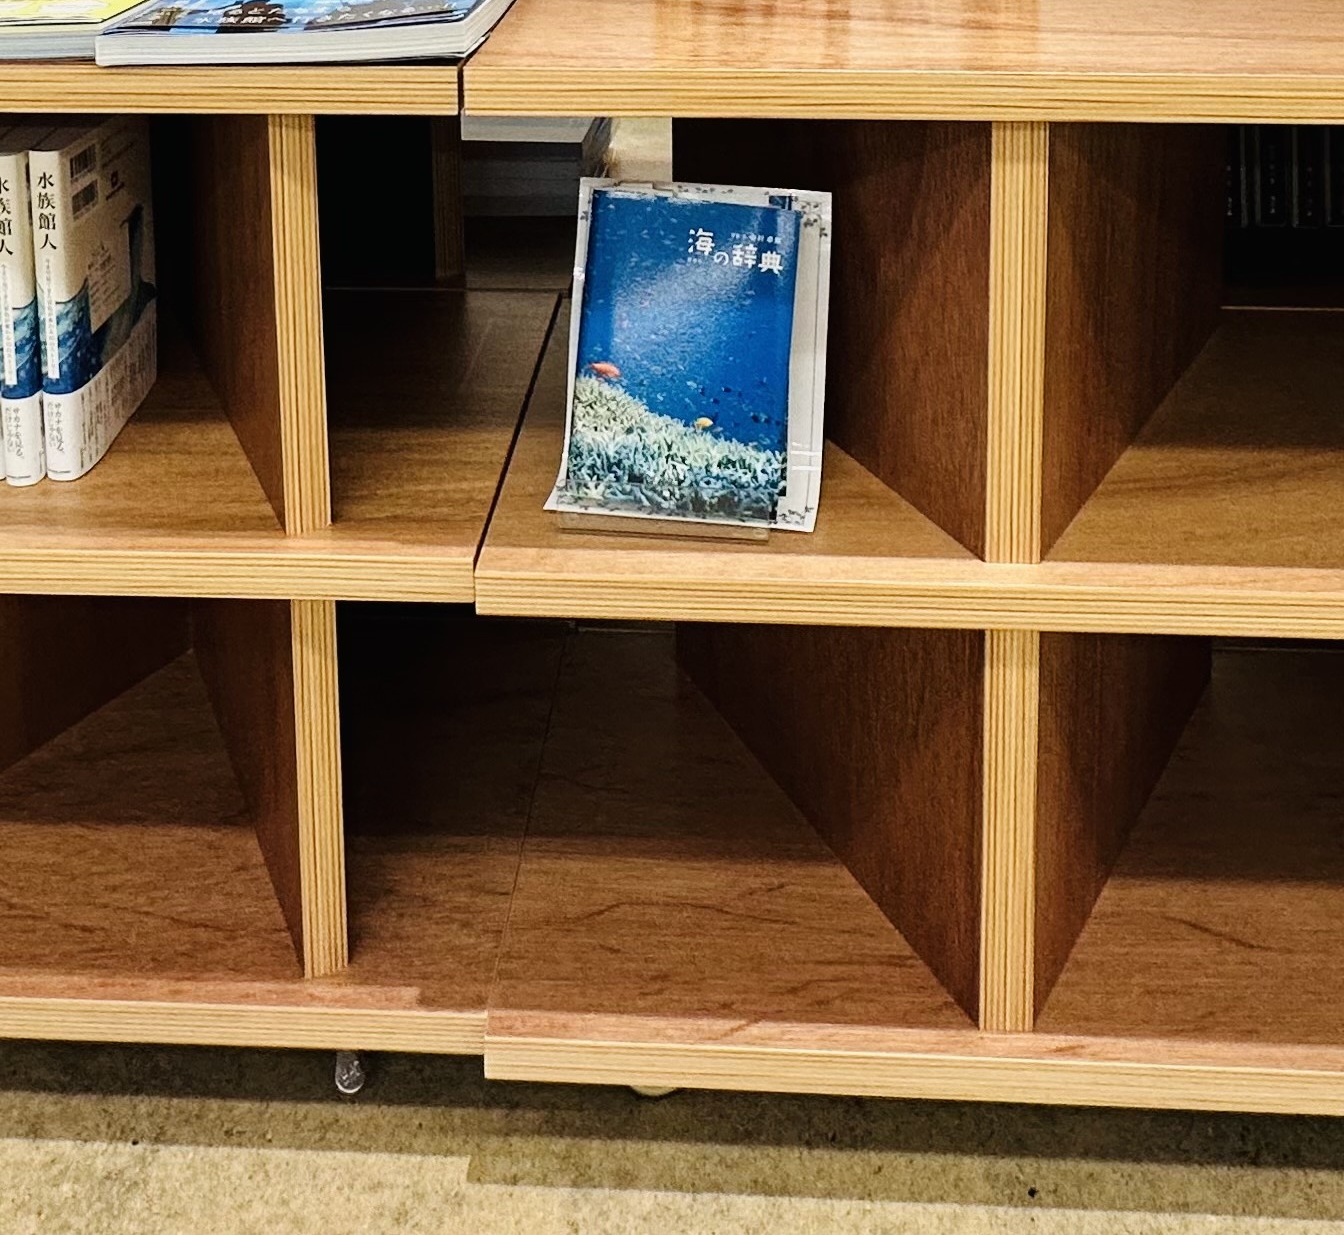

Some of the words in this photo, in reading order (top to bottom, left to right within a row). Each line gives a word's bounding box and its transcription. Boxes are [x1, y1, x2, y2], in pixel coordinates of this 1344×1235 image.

[37, 172, 57, 251] 水族館人
[687, 228, 784, 275] 海の辞典
